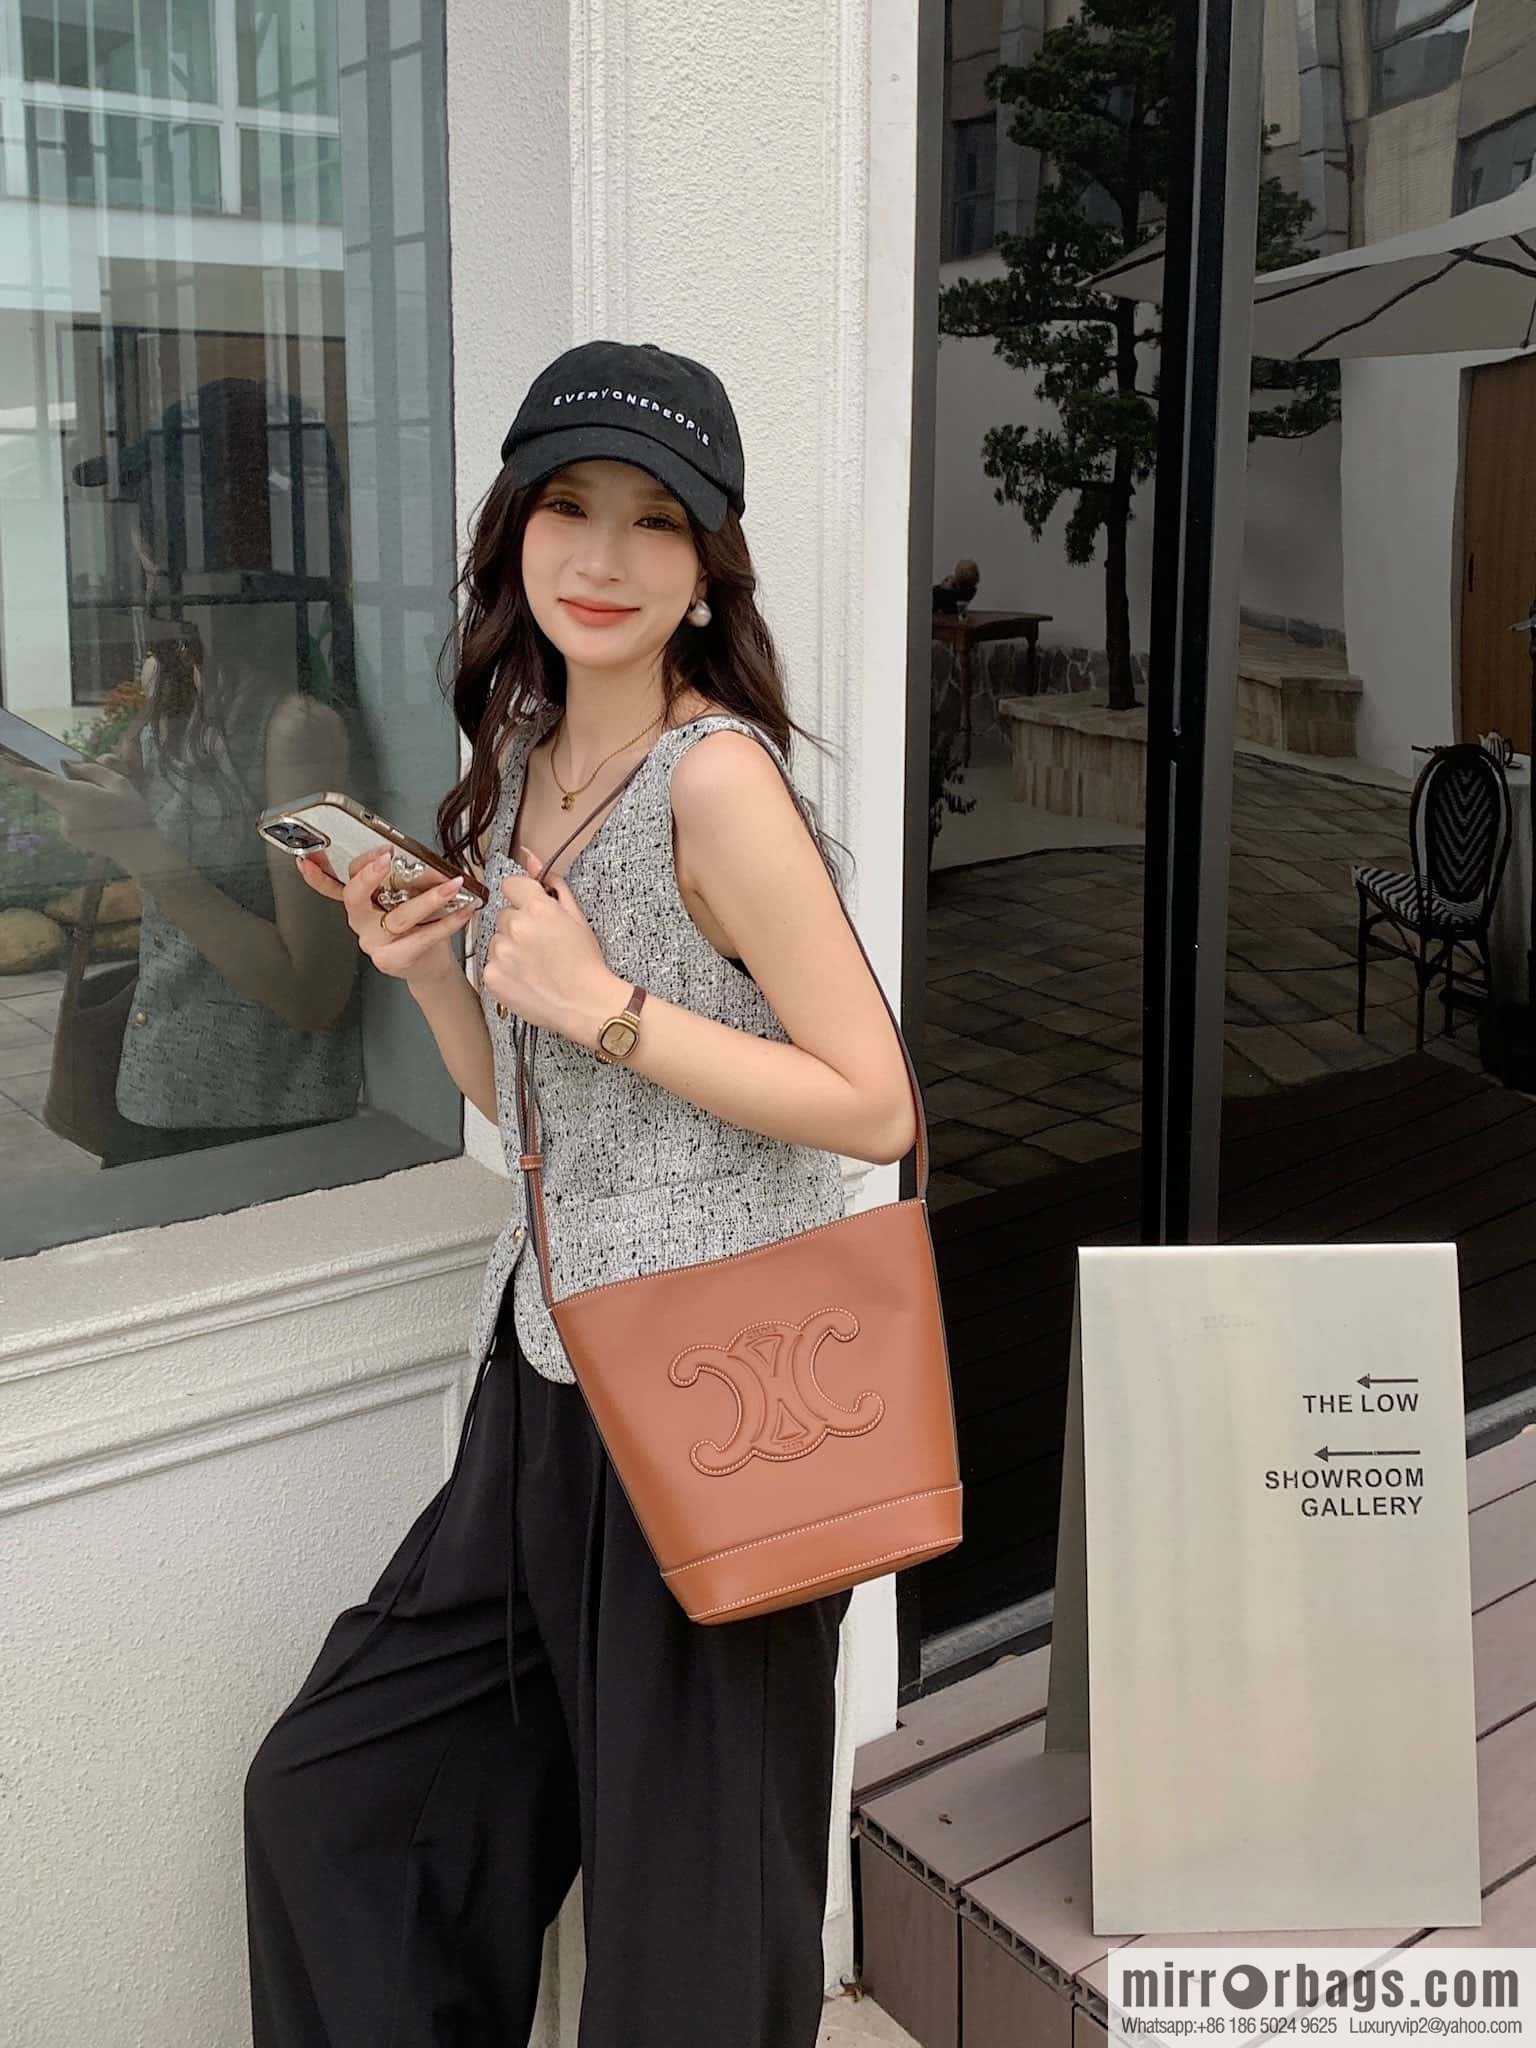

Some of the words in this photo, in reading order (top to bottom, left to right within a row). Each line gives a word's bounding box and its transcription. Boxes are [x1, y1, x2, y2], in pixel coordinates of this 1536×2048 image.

[1303, 1394, 1353, 1413] THE
[1361, 1393, 1419, 1412] LOW
[1265, 1468, 1424, 1489] SHOWROOM
[1301, 1497, 1423, 1517] GALLERY
